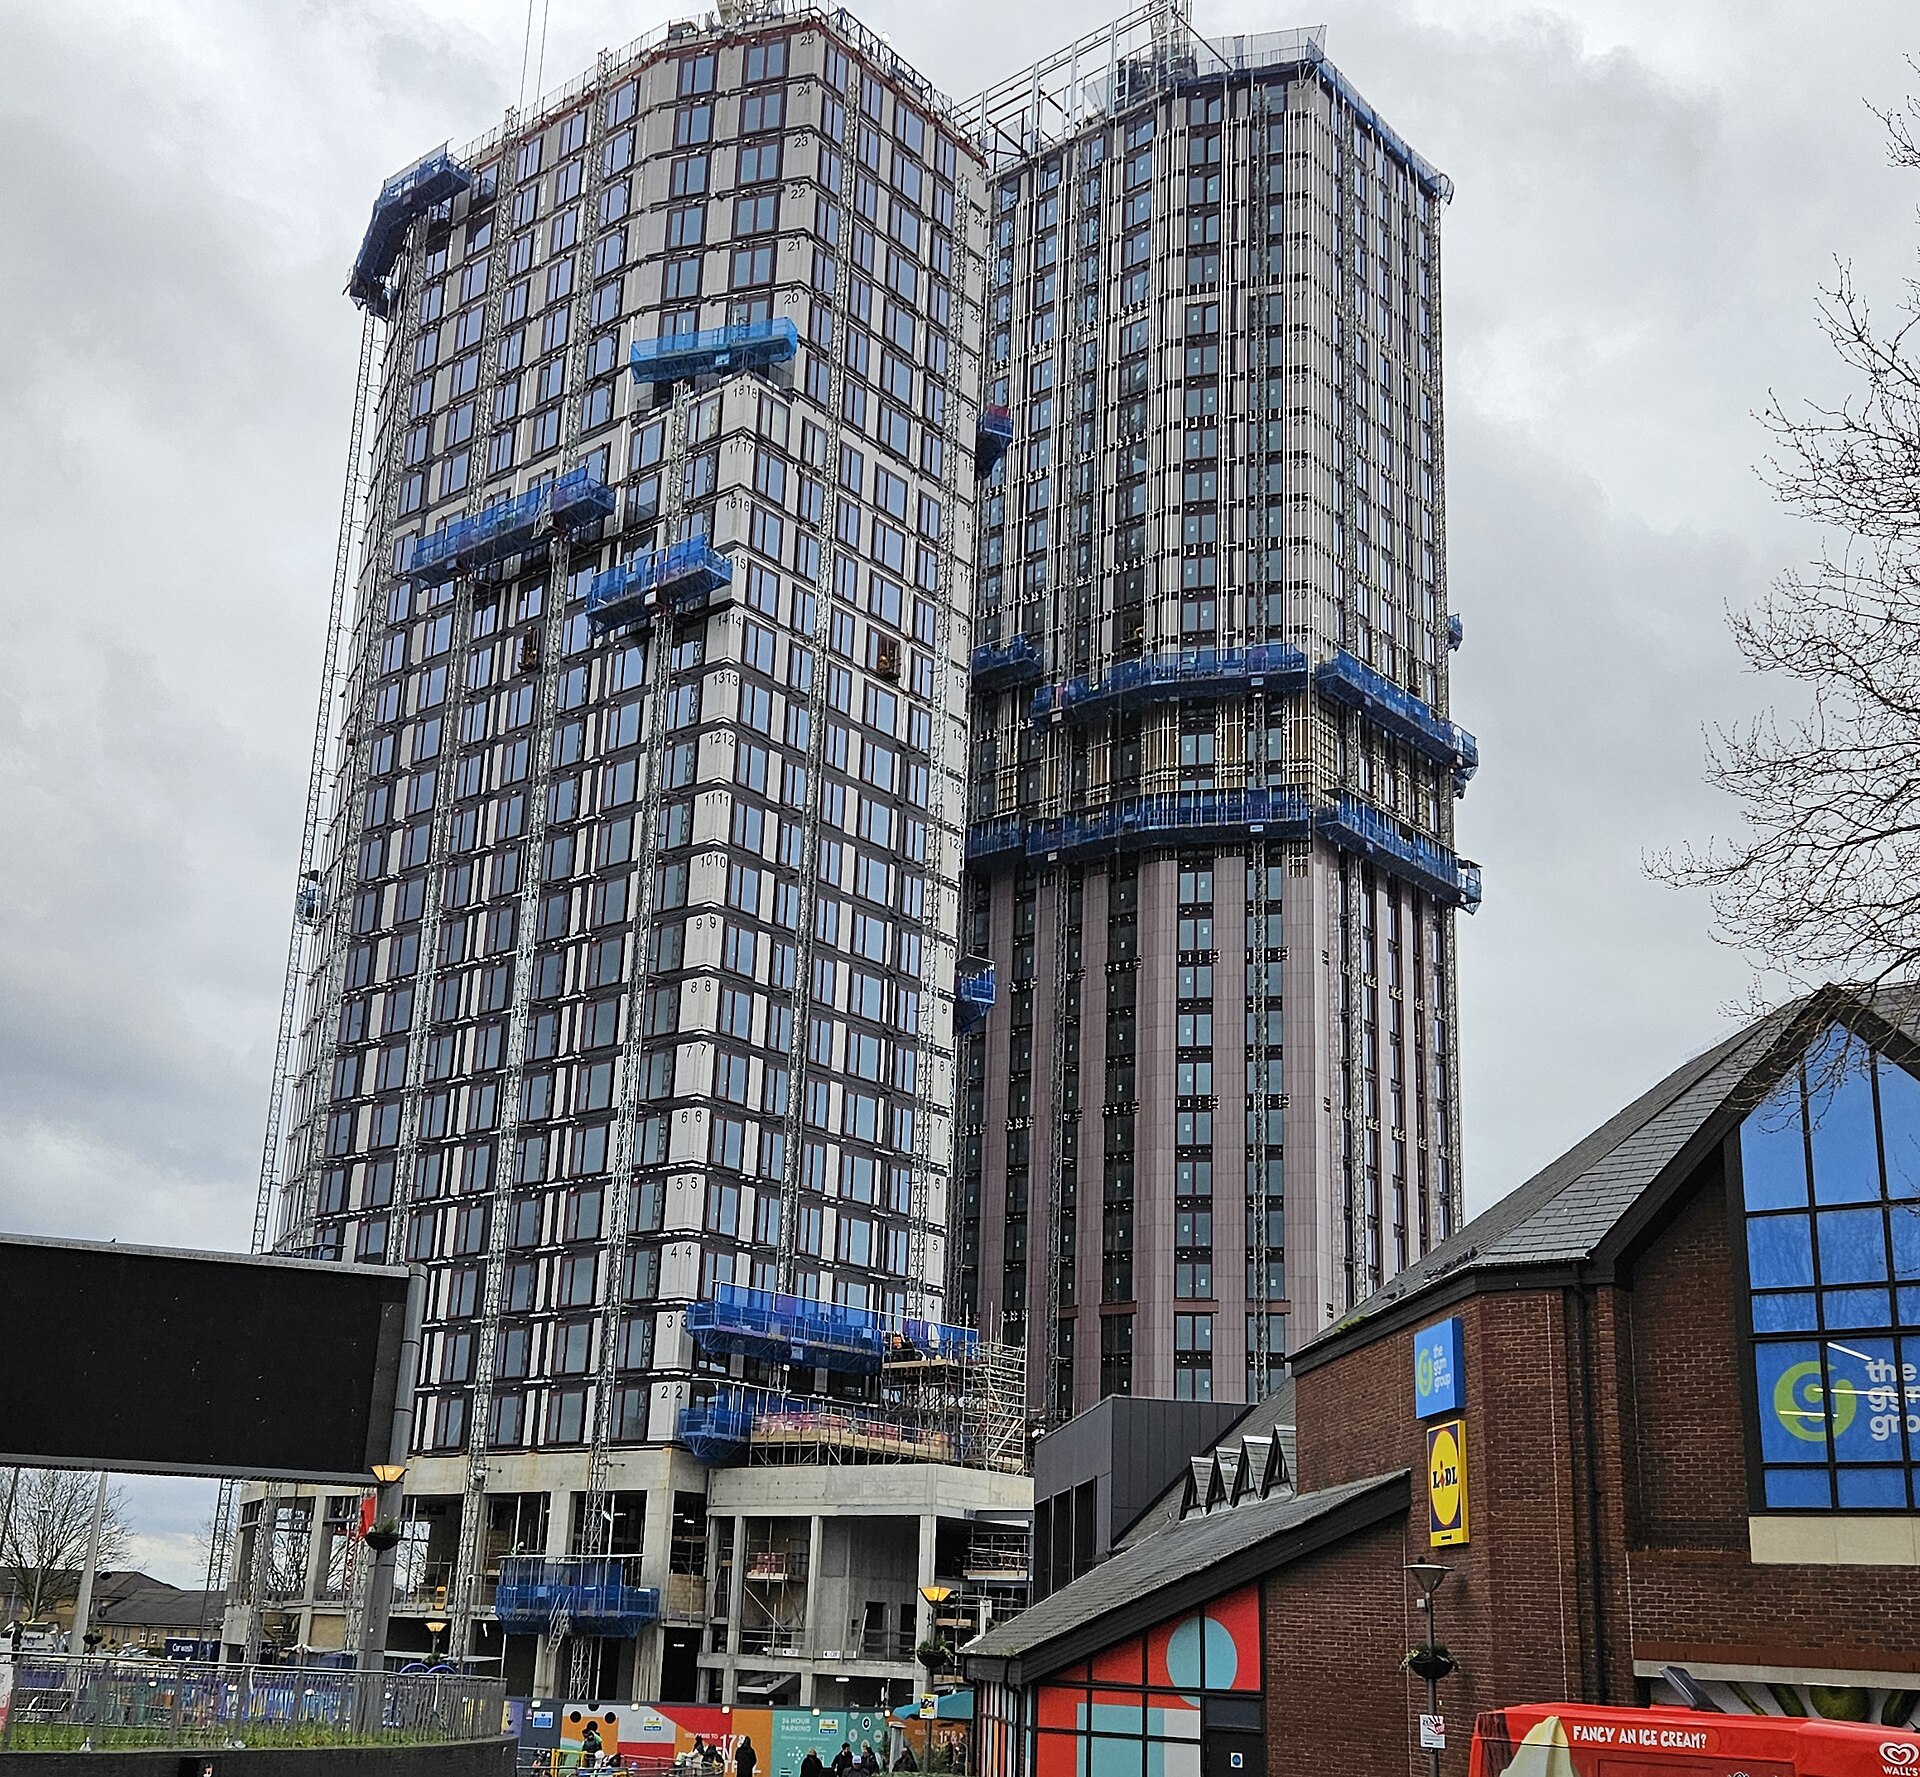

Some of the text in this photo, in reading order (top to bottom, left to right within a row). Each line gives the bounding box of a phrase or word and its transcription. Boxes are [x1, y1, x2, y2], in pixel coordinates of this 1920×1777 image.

[800, 35, 814, 46] 25
[797, 86, 811, 97] 24
[794, 137, 808, 148] 23
[790, 189, 806, 199] 22
[787, 241, 800, 252] 21
[784, 293, 799, 304] 20
[1294, 292, 1306, 300] 27
[970, 311, 979, 322] 22
[969, 360, 976, 372] 21
[1294, 375, 1306, 384] 25
[734, 385, 744, 397] 18
[747, 385, 757, 398] 18
[967, 408, 975, 422] 20
[729, 441, 740, 454] 17
[742, 441, 753, 454] 17
[964, 459, 973, 472] 19
[725, 497, 736, 511] 16
[739, 498, 750, 512] 16
[1294, 503, 1307, 512] 22
[962, 520, 970, 533] 18
[1294, 547, 1305, 556] 21
[735, 555, 746, 569] 15
[959, 572, 968, 584] 17
[1294, 591, 1306, 599] 20
[717, 612, 728, 626] 14
[731, 613, 741, 628] 14
[957, 624, 966, 636] 16
[713, 671, 724, 685] 13
[727, 672, 738, 686] 13
[954, 676, 964, 688] 15
[709, 732, 720, 745] 12
[723, 733, 734, 746] 12
[953, 729, 962, 741] 14
[951, 782, 960, 795] 13
[705, 793, 715, 806] 11
[718, 792, 729, 806] 11
[949, 837, 959, 850] 12
[701, 854, 712, 868] 10
[714, 854, 726, 868] 10
[946, 892, 956, 904] 11
[696, 918, 702, 930] 9
[710, 916, 716, 929] 9
[944, 948, 954, 960] 10
[691, 981, 697, 994] 8
[705, 980, 711, 992] 8
[942, 1003, 947, 1015] 9
[687, 1045, 692, 1057] 7
[701, 1043, 706, 1056] 7
[939, 1061, 945, 1072] 8
[682, 1111, 688, 1124] 6
[696, 1110, 702, 1123] 6
[937, 1119, 942, 1130] 7
[677, 1178, 683, 1190] 5
[691, 1177, 697, 1190] 5
[935, 1178, 940, 1190] 6
[671, 1246, 678, 1258] 4
[685, 1245, 692, 1258] 4
[932, 1240, 938, 1252] 5
[929, 1300, 935, 1311] 4
[666, 1315, 673, 1328] 3
[680, 1314, 687, 1328] 3
[1434, 1344, 1443, 1358] the
[1434, 1357, 1447, 1376] gym
[1865, 1358, 1917, 1382] the
[1434, 1373, 1450, 1393] group
[661, 1386, 668, 1399] 2
[676, 1386, 683, 1399] 2
[1573, 1726, 1706, 1748] FANCY AN ICE CREAM?
[1882, 1765, 1918, 1776] WALL'S
